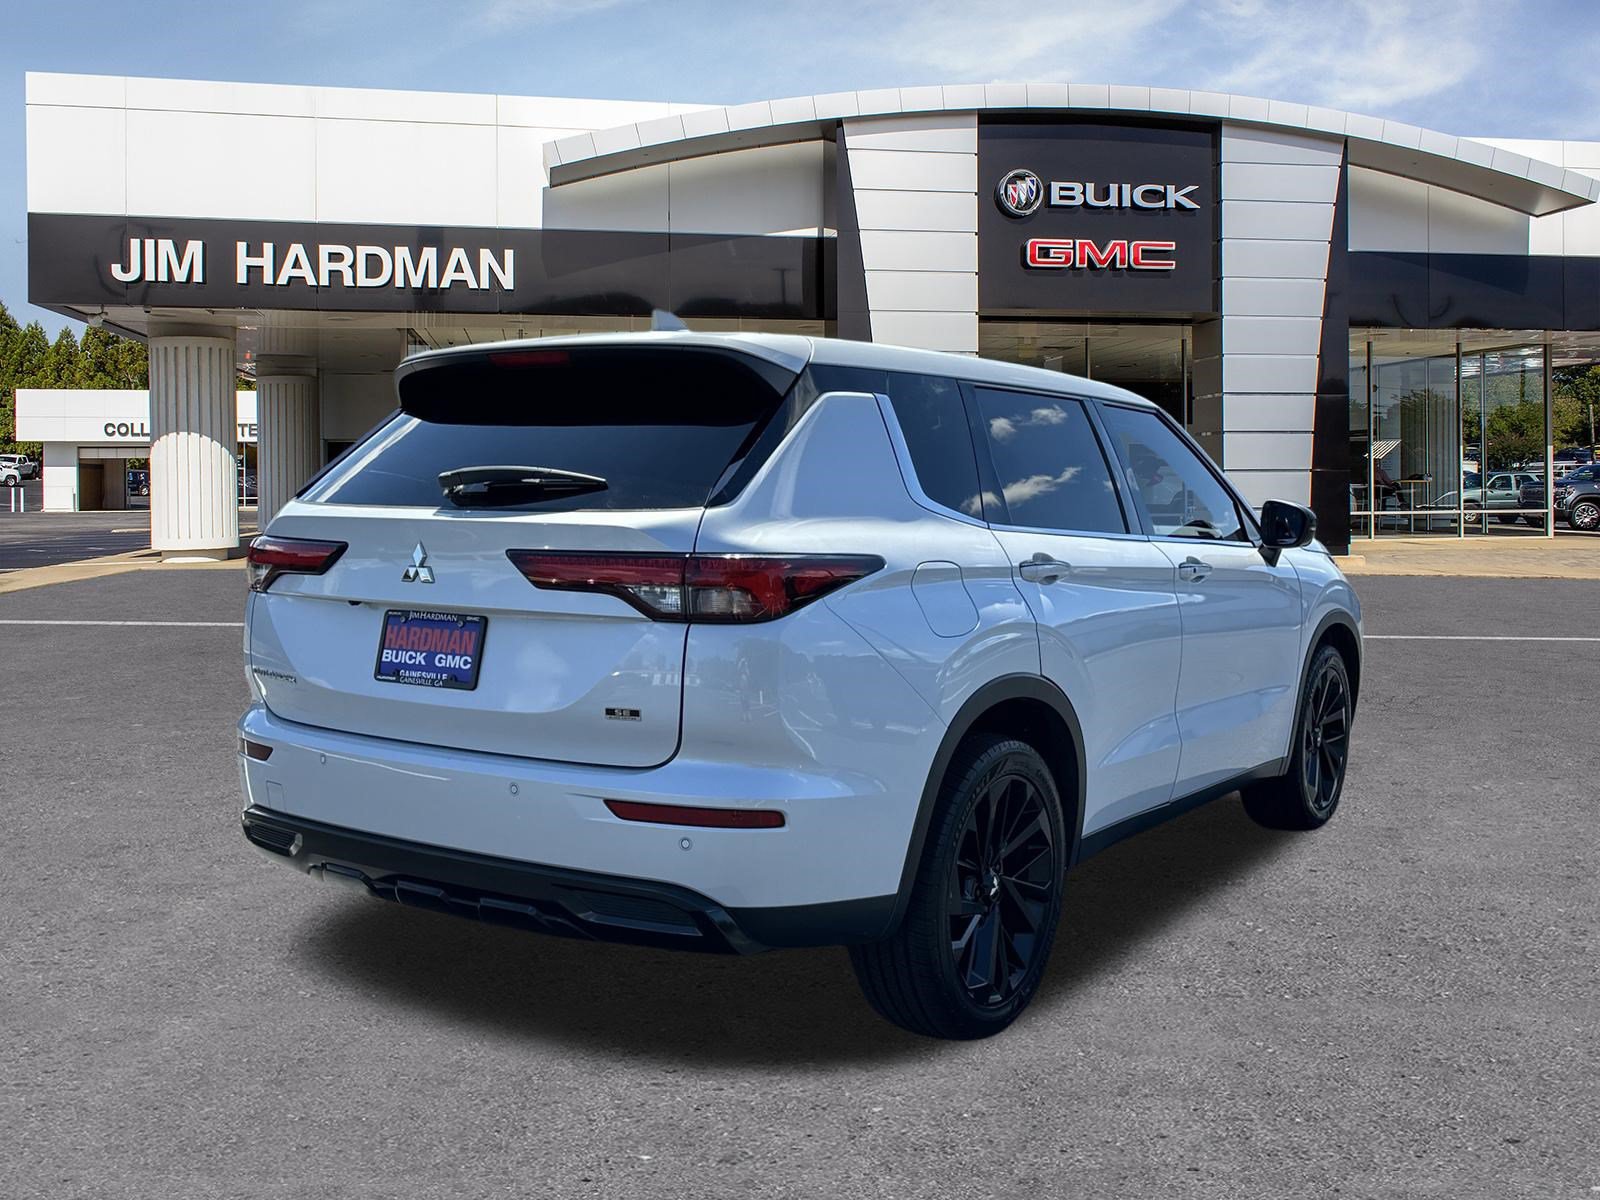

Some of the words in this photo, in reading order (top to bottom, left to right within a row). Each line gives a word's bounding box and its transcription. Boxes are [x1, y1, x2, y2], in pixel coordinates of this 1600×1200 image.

[1050, 181, 1200, 210] BUICK
[111, 237, 205, 284] JIM
[236, 241, 515, 291] HARDMAN
[1026, 238, 1176, 270] GMC
[384, 625, 476, 655] HARDMAN
[382, 649, 427, 665] BUICK
[434, 654, 472, 670] GMC
